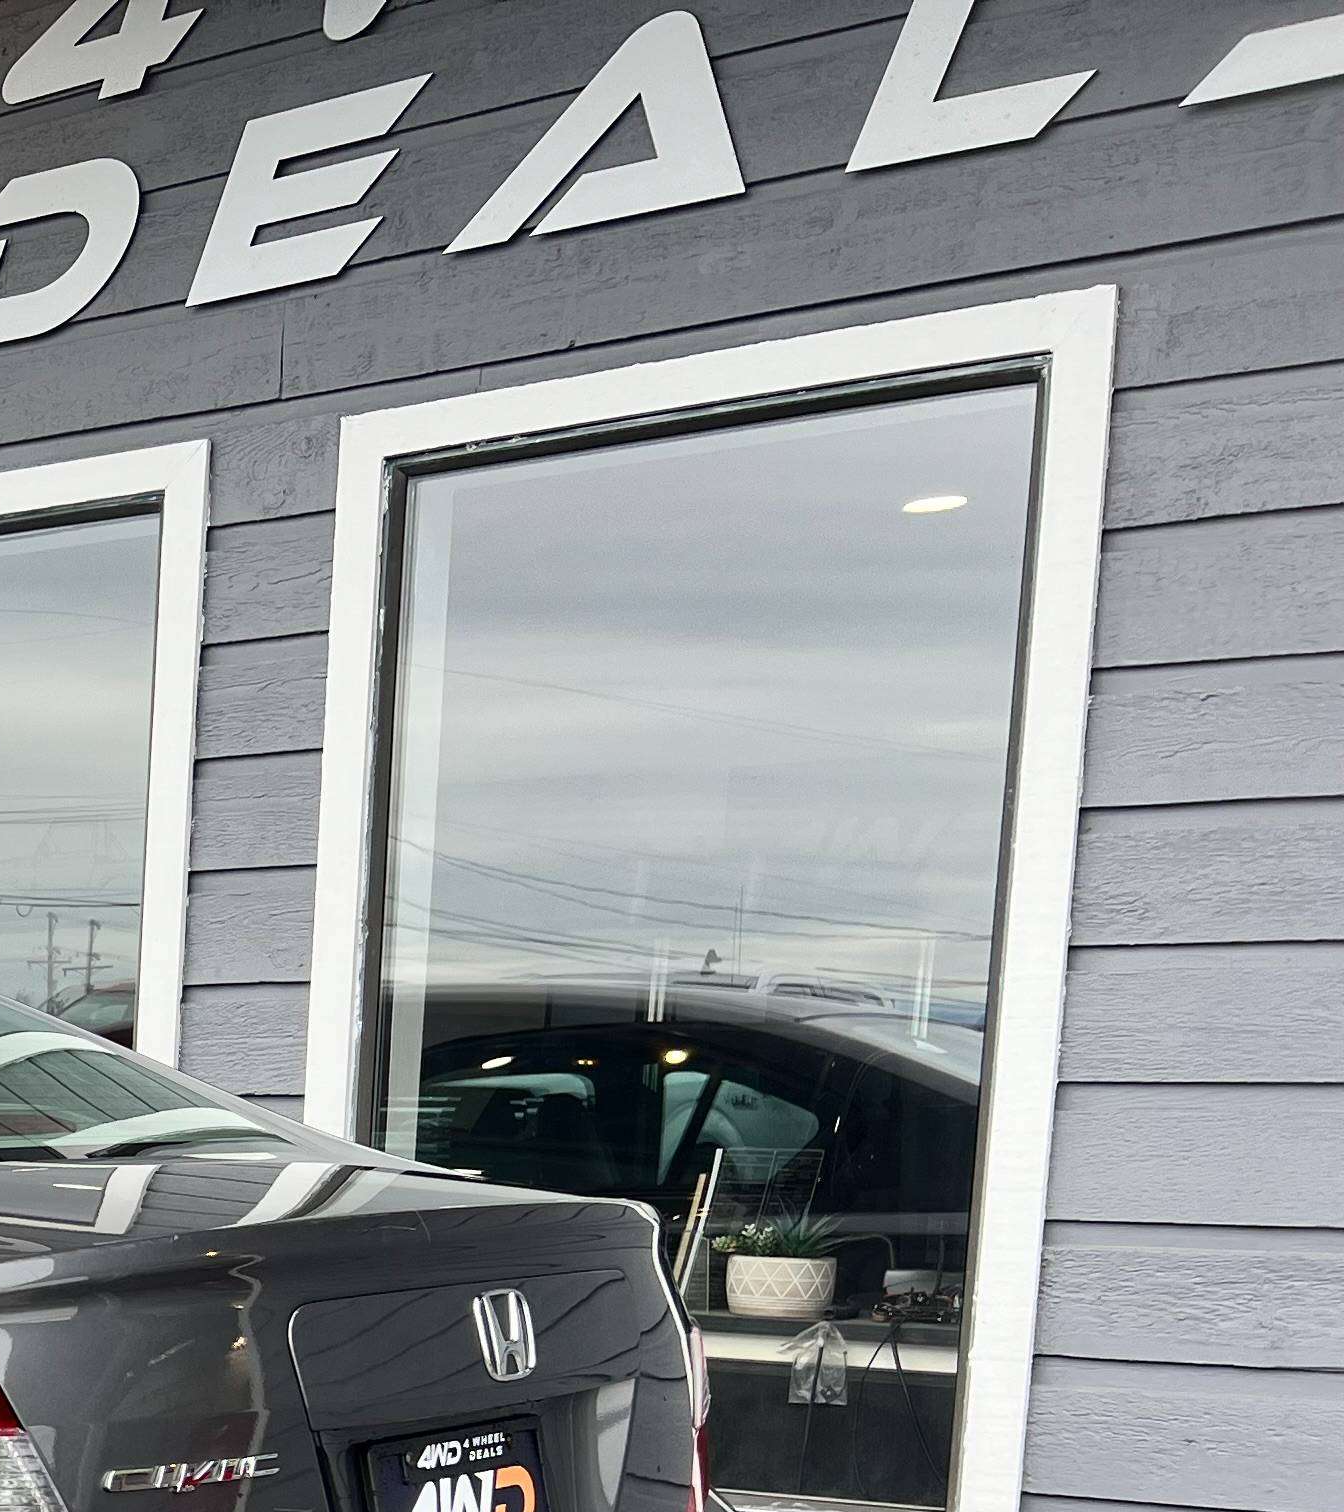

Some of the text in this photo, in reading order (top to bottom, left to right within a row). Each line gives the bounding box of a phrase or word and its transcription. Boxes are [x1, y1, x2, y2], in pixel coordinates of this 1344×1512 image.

[417, 1432, 506, 1469] 4WD 4 WHEEL
[469, 1445, 504, 1462] DEALS
